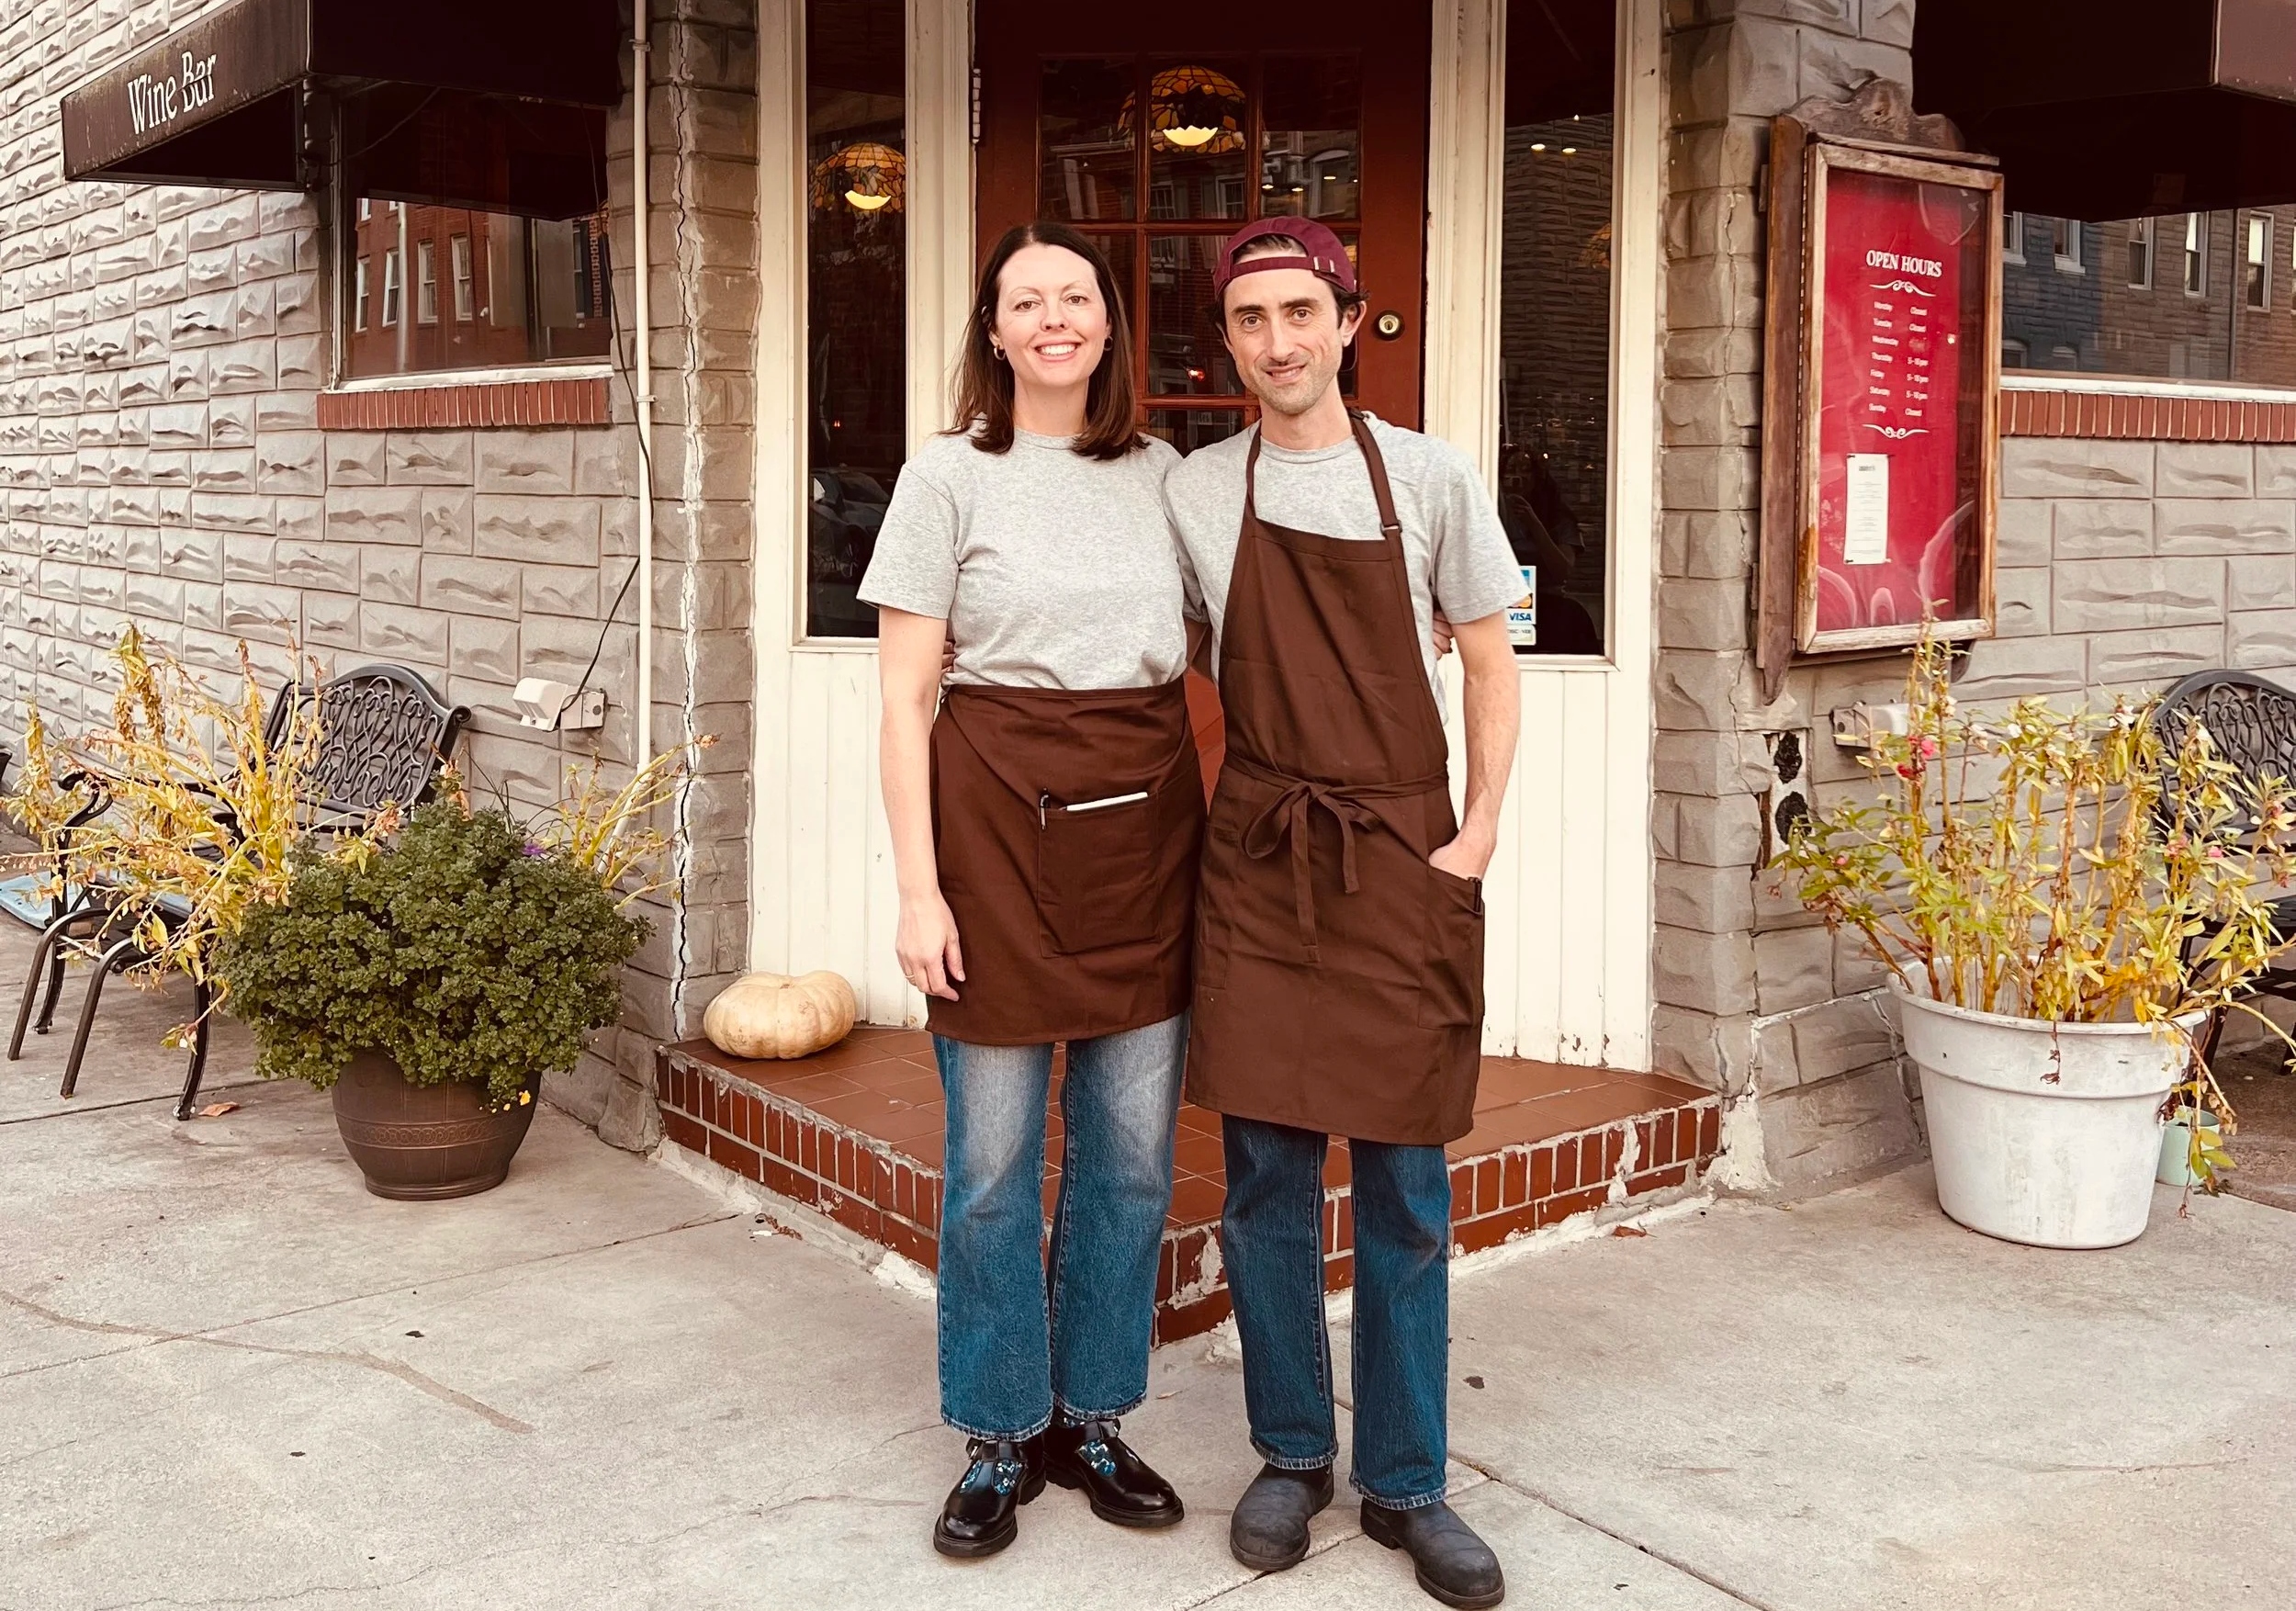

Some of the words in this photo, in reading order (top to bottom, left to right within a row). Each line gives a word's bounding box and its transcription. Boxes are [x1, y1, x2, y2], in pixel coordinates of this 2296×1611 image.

[128, 73, 177, 135] Wine
[181, 51, 217, 113] Bar
[1866, 249, 1899, 270] OPEN
[1900, 255, 1942, 278] HOURS
[1509, 613, 1532, 621] VISA
